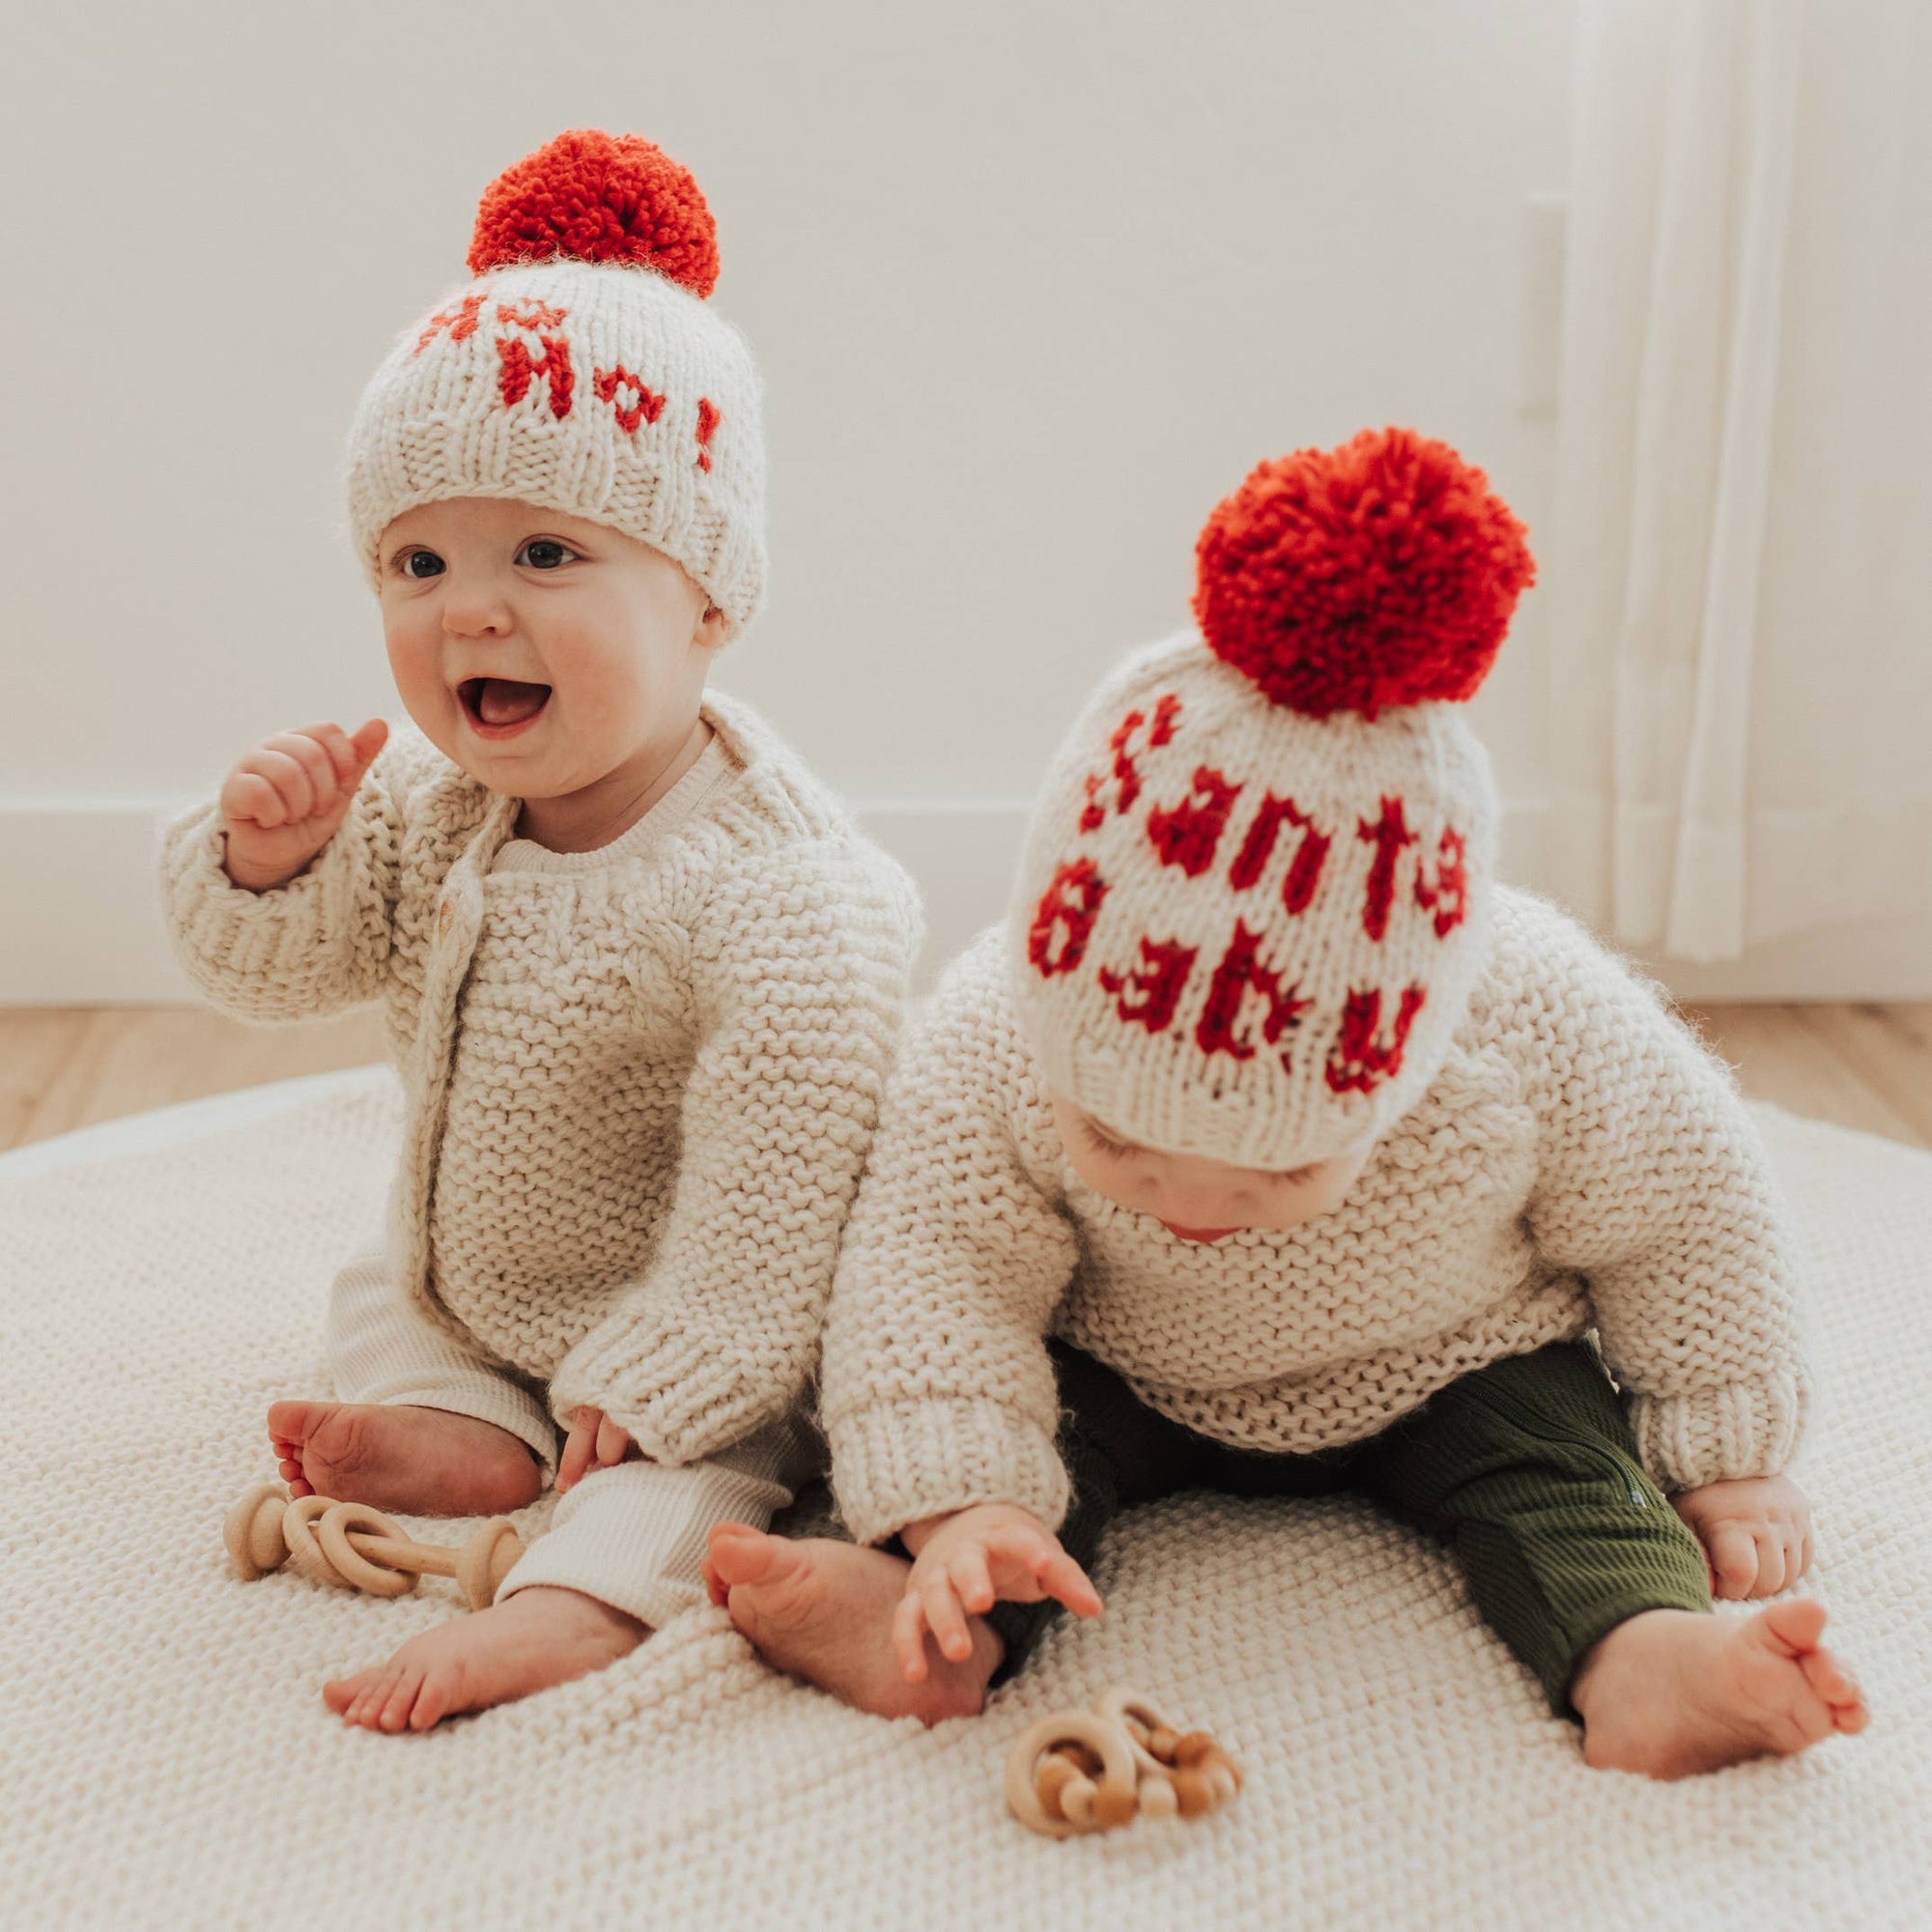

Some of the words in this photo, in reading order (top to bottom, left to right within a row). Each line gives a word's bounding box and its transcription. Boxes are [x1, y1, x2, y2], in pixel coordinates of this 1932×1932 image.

[495, 334, 722, 473] Ho!
[1077, 694, 1467, 944] Santa
[1026, 857, 1428, 1096] Baby
